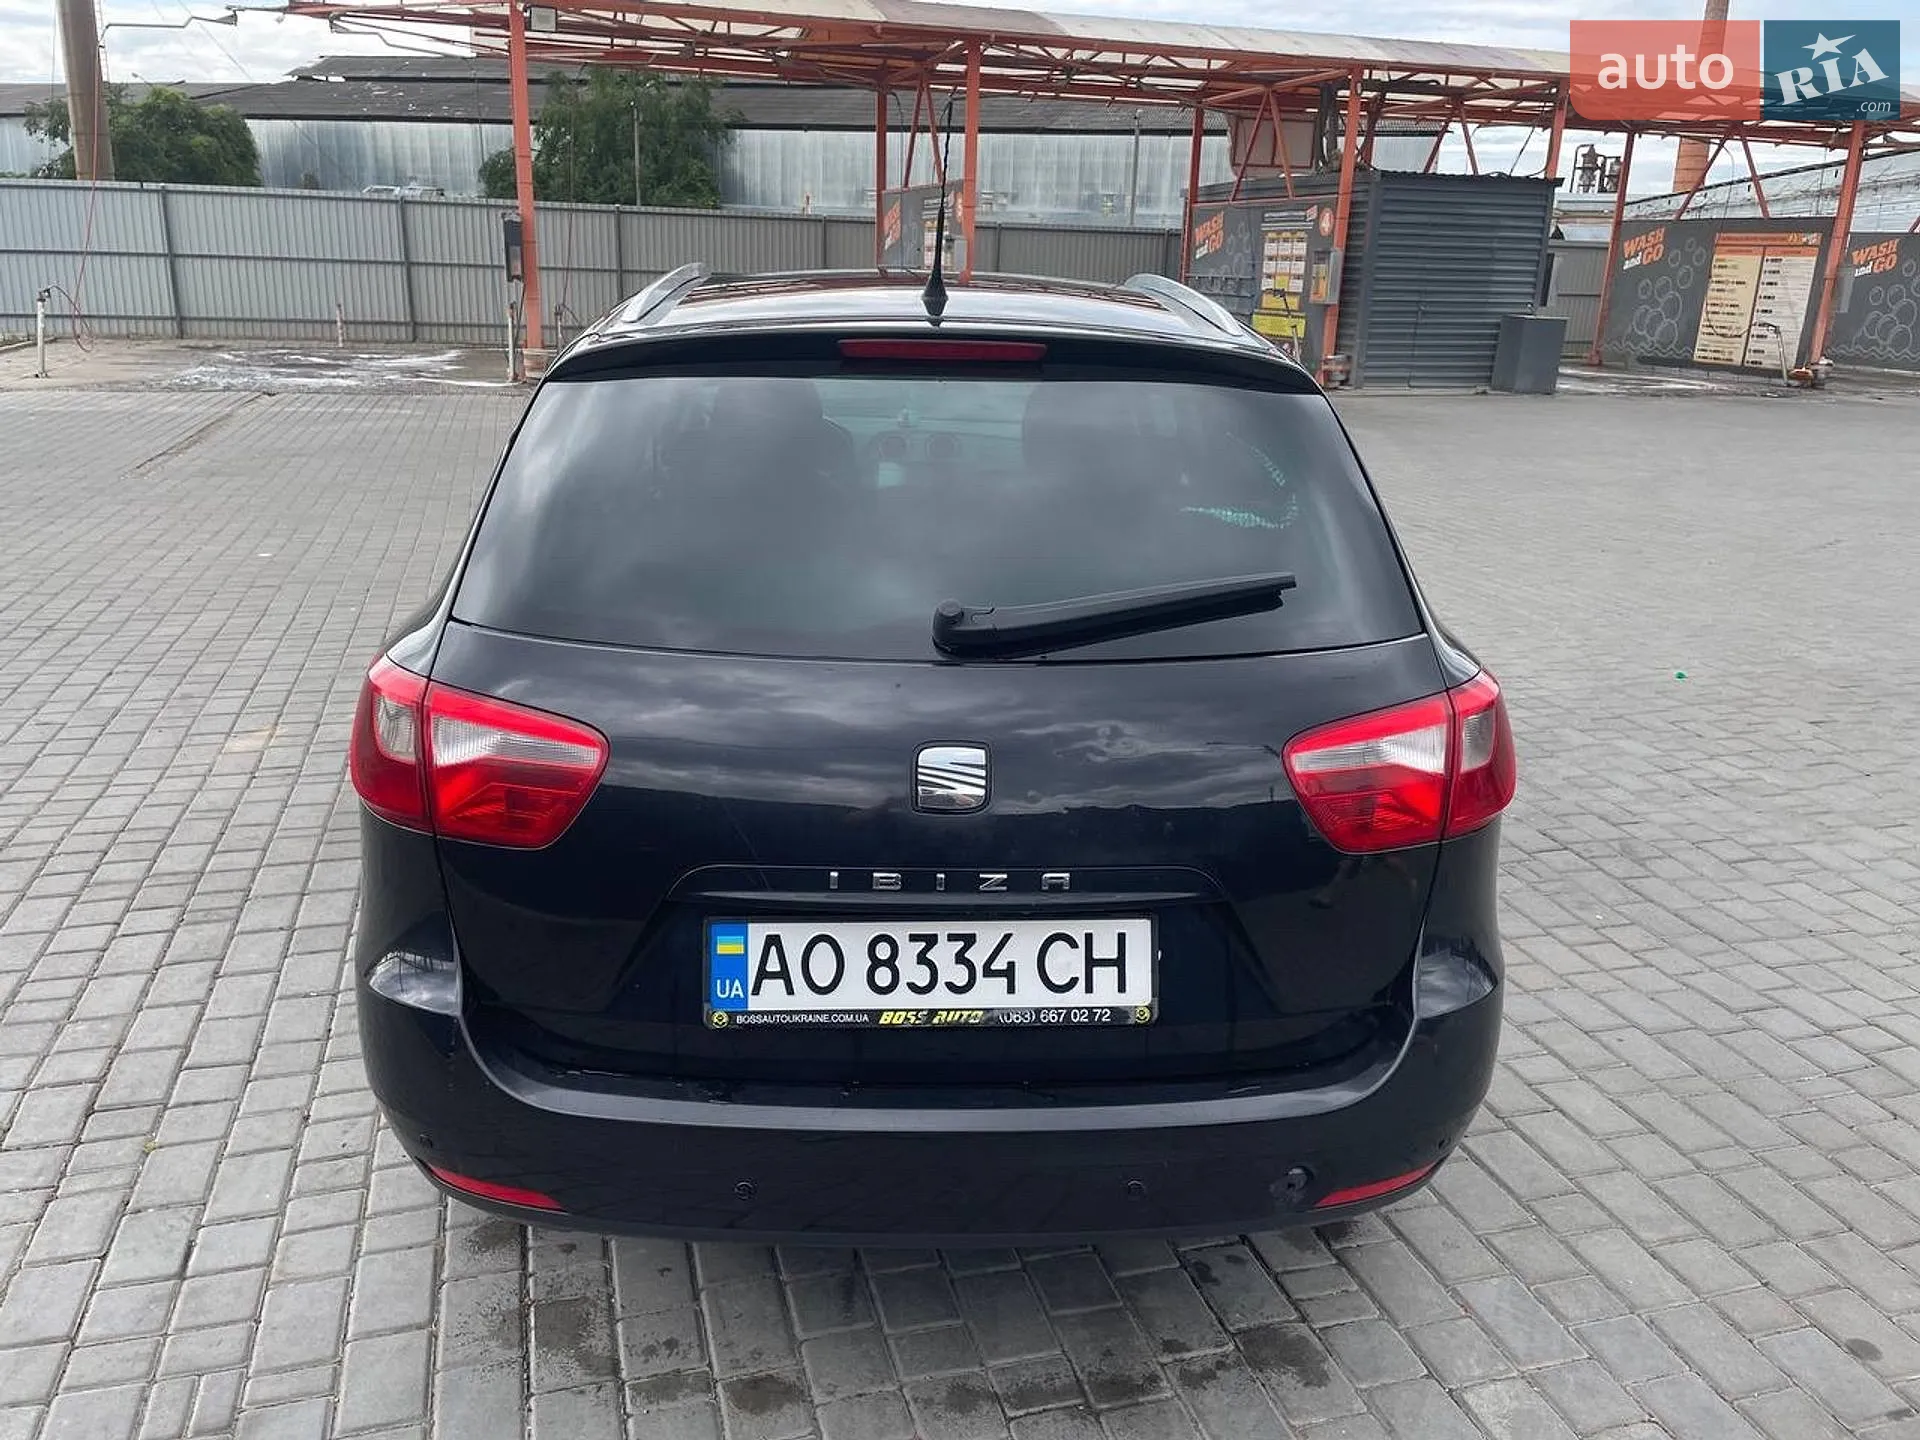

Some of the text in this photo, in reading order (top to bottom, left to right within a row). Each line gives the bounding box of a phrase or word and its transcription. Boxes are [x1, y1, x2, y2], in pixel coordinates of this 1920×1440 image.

[1623, 227, 1665, 259] WASH
[1852, 239, 1899, 265] WASH
[1642, 243, 1664, 265] GO
[1872, 254, 1897, 273] GO
[829, 871, 1071, 891] IBIZA
[751, 931, 1127, 996] AO 8334 CH
[716, 979, 744, 998] UA
[736, 1013, 869, 1025] BOSSAUTOUKRAINE.COM.UA
[878, 1010, 929, 1025] BOSS
[932, 1010, 984, 1025] AUTO
[1039, 1008, 1067, 1023] 667
[1070, 1009, 1089, 1023] 02
[1093, 1008, 1111, 1023] 72
